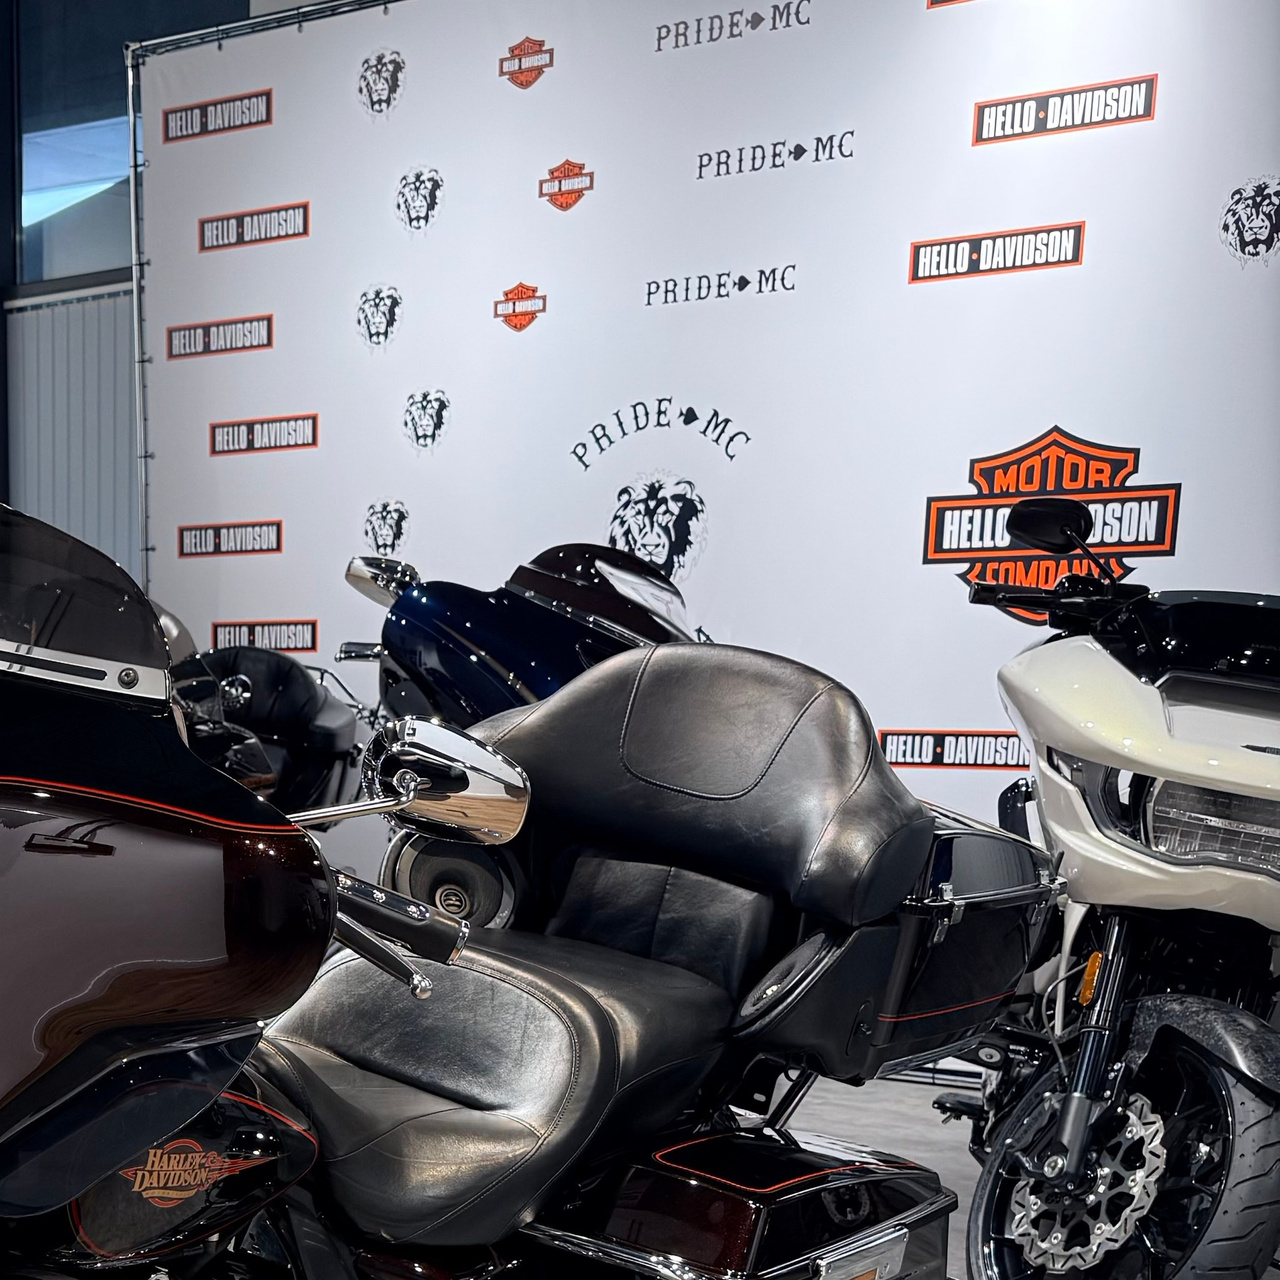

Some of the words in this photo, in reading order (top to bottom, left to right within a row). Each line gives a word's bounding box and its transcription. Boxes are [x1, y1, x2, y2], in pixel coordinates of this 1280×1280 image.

[654, 8, 744, 52] PRIDE
[769, 0, 811, 31] MC
[168, 109, 200, 138] HELLO
[207, 95, 267, 130] DAVIDSON
[982, 100, 1036, 138] HELLO
[1046, 83, 1147, 129] DAVIDSON
[696, 140, 787, 180] PRIDE
[812, 130, 855, 163] MC
[204, 219, 237, 247] HELLO
[243, 208, 304, 241] DAVIDSON
[918, 242, 970, 278] HELLO
[979, 229, 1075, 271] DAVIDSON
[644, 271, 732, 307] PRIDE
[756, 264, 797, 295] MC
[172, 328, 204, 355] HELLO
[210, 319, 268, 350] DAVIDSON
[215, 426, 248, 451] HELLO
[253, 419, 312, 449] DAVIDSON
[569, 396, 673, 472] PRIDE
[699, 408, 752, 462] MC
[994, 445, 1112, 493] MOTOR
[183, 529, 215, 554] HELLO
[220, 525, 277, 552] DAVIDSON
[942, 507, 1011, 549] HELLO
[255, 624, 312, 649] DAVIDSON
[886, 735, 934, 763] HELLO
[132, 1167, 210, 1192] DAVIDSON
